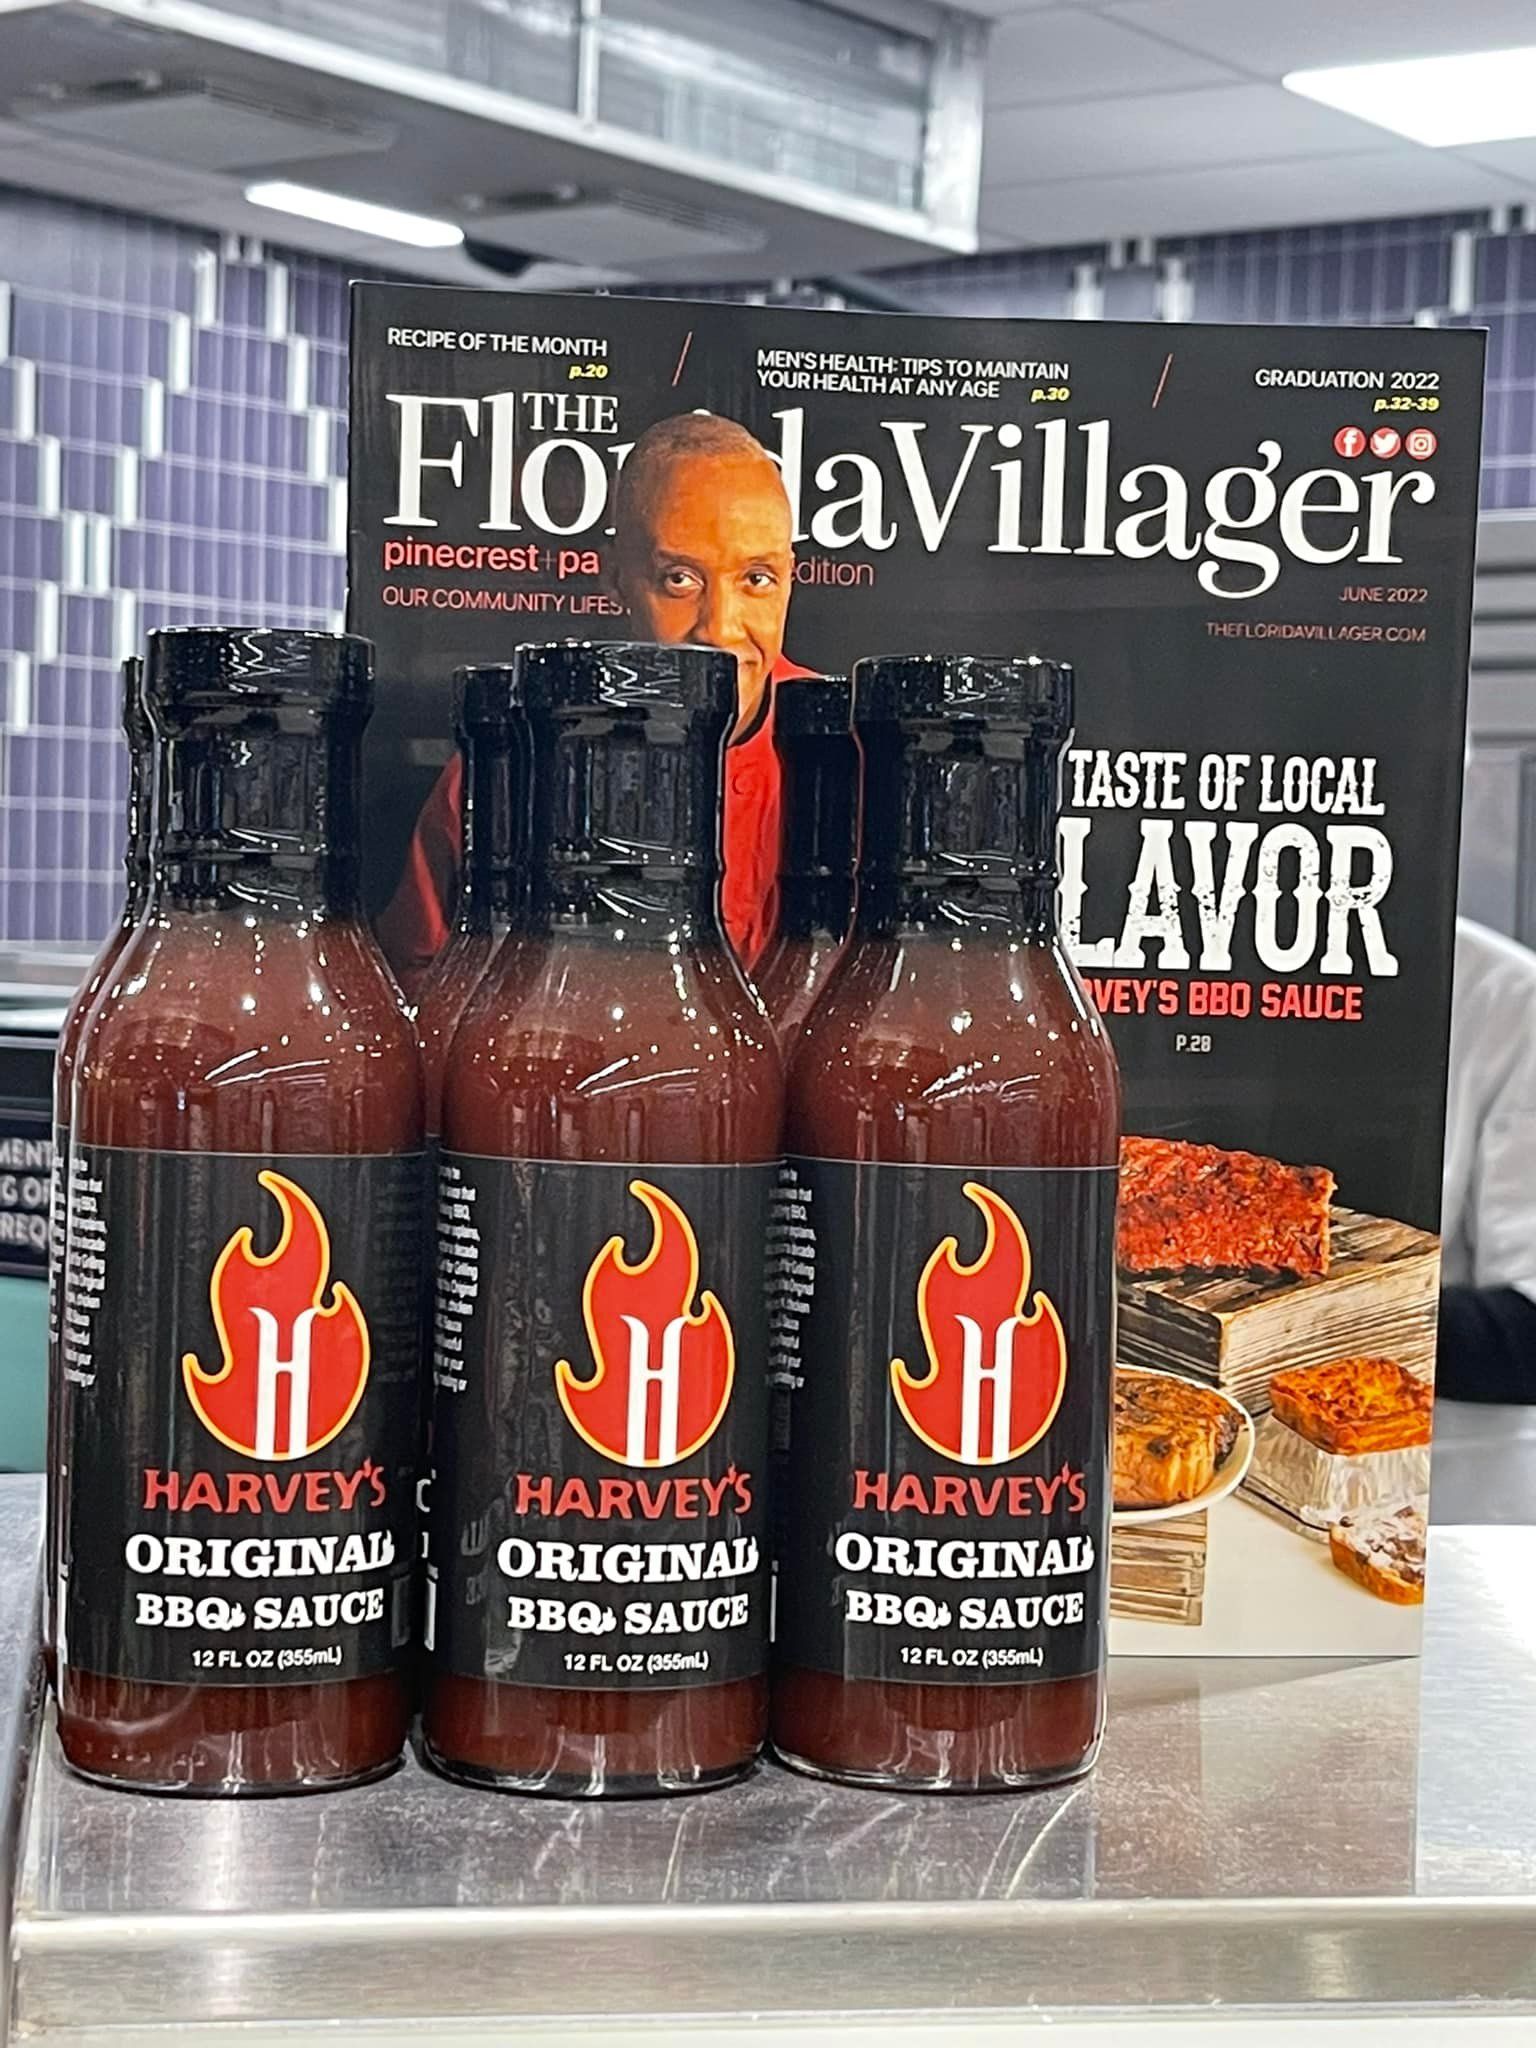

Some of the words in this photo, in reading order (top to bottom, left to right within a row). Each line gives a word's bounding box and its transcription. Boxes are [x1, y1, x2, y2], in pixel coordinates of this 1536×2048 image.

[388, 327, 456, 350] RECIPE
[458, 331, 486, 350] OF
[490, 333, 529, 354] THE
[531, 336, 608, 357] MONTH
[568, 363, 609, 379] p.20
[757, 350, 817, 371] MEN'S
[819, 355, 898, 374] HEALTH:
[901, 358, 943, 376] TIPS
[945, 359, 973, 377] TO
[975, 361, 1069, 380] MAINTAIN
[1255, 368, 1385, 389] GRADUATION
[1390, 372, 1440, 391] 2022
[757, 370, 817, 390] YOUR
[814, 373, 888, 393] HEALTH
[889, 377, 914, 394] AT
[916, 379, 963, 396] ANY
[960, 381, 1000, 399] AGE
[1030, 387, 1070, 402] p.30
[522, 391, 619, 434] THE
[1373, 397, 1440, 412] p.32-39
[792, 556, 874, 586] dition
[382, 586, 428, 608] OUR
[432, 588, 566, 612] COMMUNITY
[1339, 586, 1383, 602] JUNE
[1386, 588, 1429, 603] 2022
[1206, 621, 1428, 643] THEFLORIDAVILLAGER.COM
[1067, 749, 1187, 810] TASTE
[1199, 754, 1251, 811] OF
[1258, 755, 1386, 816] LOCAL
[1188, 981, 1251, 1018] BBQ
[1260, 983, 1363, 1021] SAUCE
[1175, 1034, 1212, 1053] P.28
[143, 1457, 387, 1514] HARVEY'S
[515, 1462, 752, 1519] HARVEY'S
[853, 1461, 1086, 1516] HARVEY'S
[125, 1530, 395, 1578] ORIGINAL
[497, 1536, 759, 1583] ORIGINAL
[834, 1532, 1095, 1579] ORIGINAL
[135, 1592, 245, 1631] BBQ
[253, 1588, 384, 1631] SAUCE
[507, 1597, 616, 1635] BBQ
[624, 1593, 749, 1635] SAUCE
[845, 1589, 951, 1629] BBQ
[959, 1592, 1084, 1630] SAUCE
[192, 1650, 214, 1667] 12
[219, 1651, 242, 1667] FL
[246, 1652, 274, 1668] OZ
[277, 1647, 343, 1671] (355mL)
[564, 1654, 586, 1671] 12
[590, 1655, 613, 1671] FL
[616, 1655, 644, 1672] OZ
[647, 1650, 709, 1674] (355mL)
[900, 1648, 922, 1664] 12
[925, 1648, 948, 1665] FL
[951, 1649, 978, 1667] OZ
[981, 1646, 1044, 1669] (355mL)
